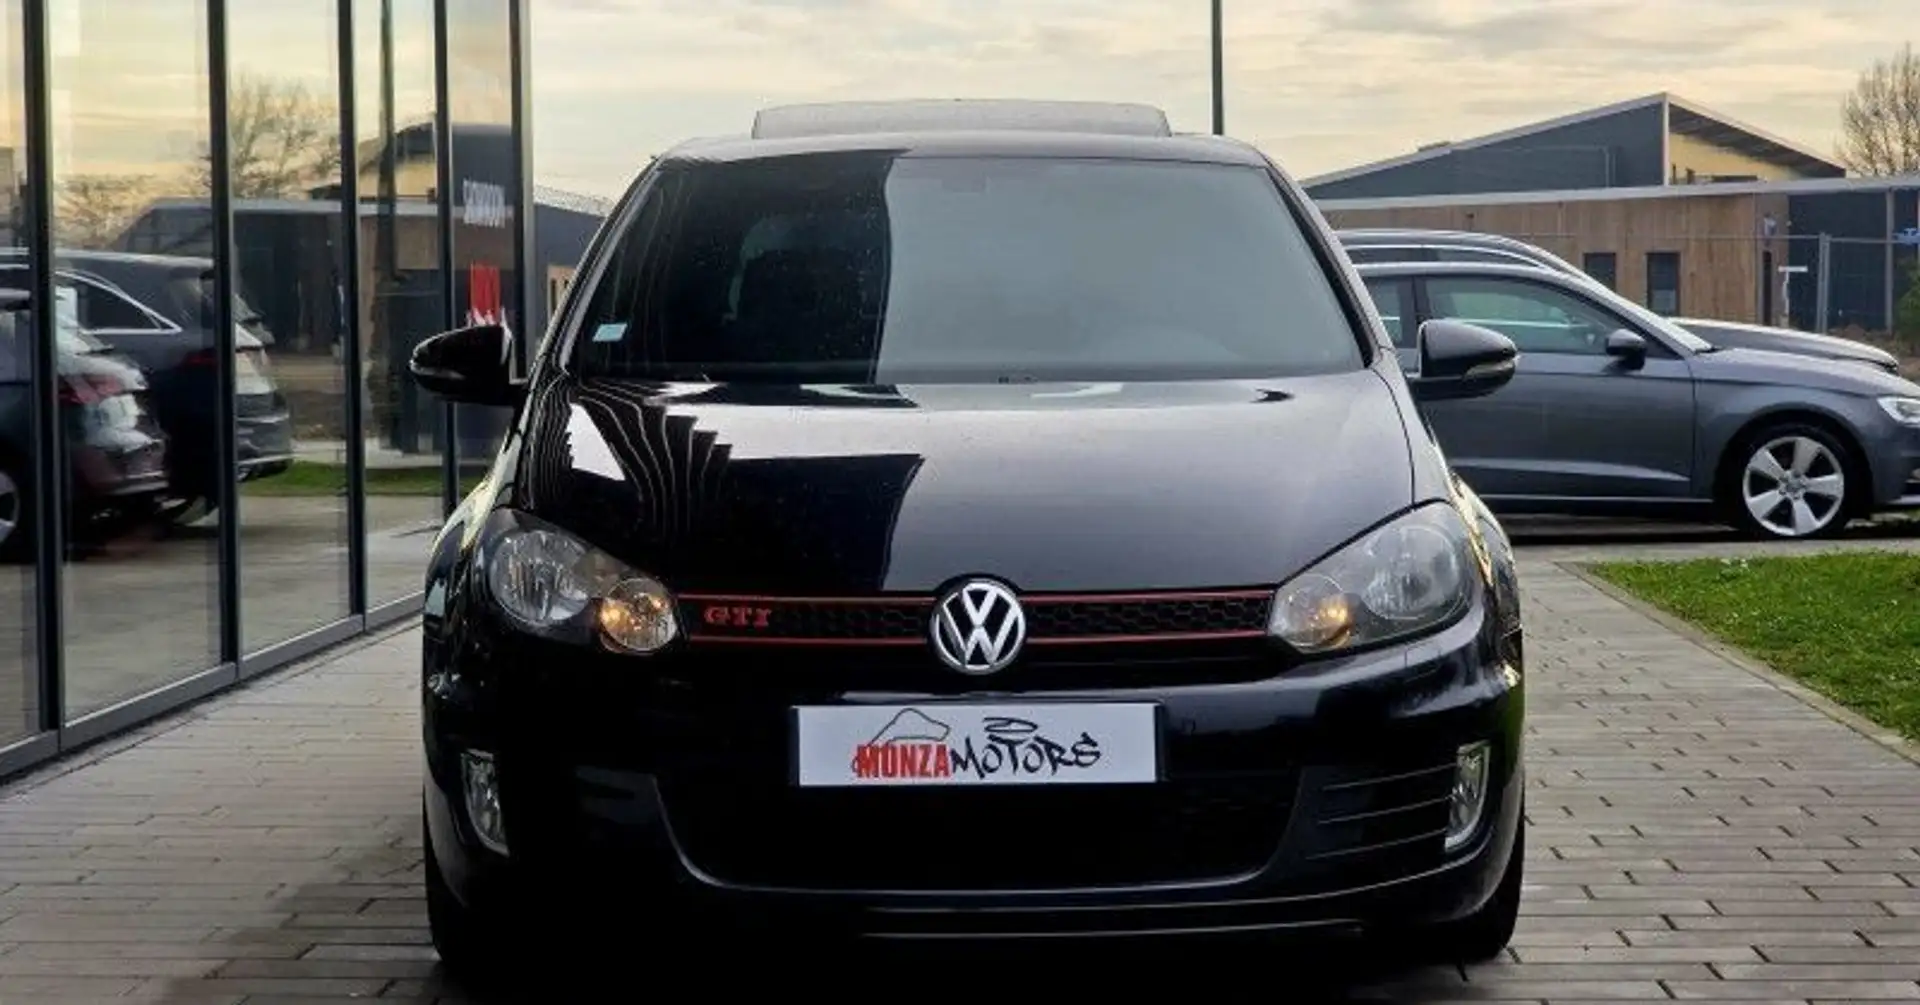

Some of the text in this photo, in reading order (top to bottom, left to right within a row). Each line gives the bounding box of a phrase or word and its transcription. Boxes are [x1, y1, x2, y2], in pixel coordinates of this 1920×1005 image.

[703, 606, 772, 627] GTI
[938, 581, 1021, 669] VW
[856, 744, 950, 777] MONZA
